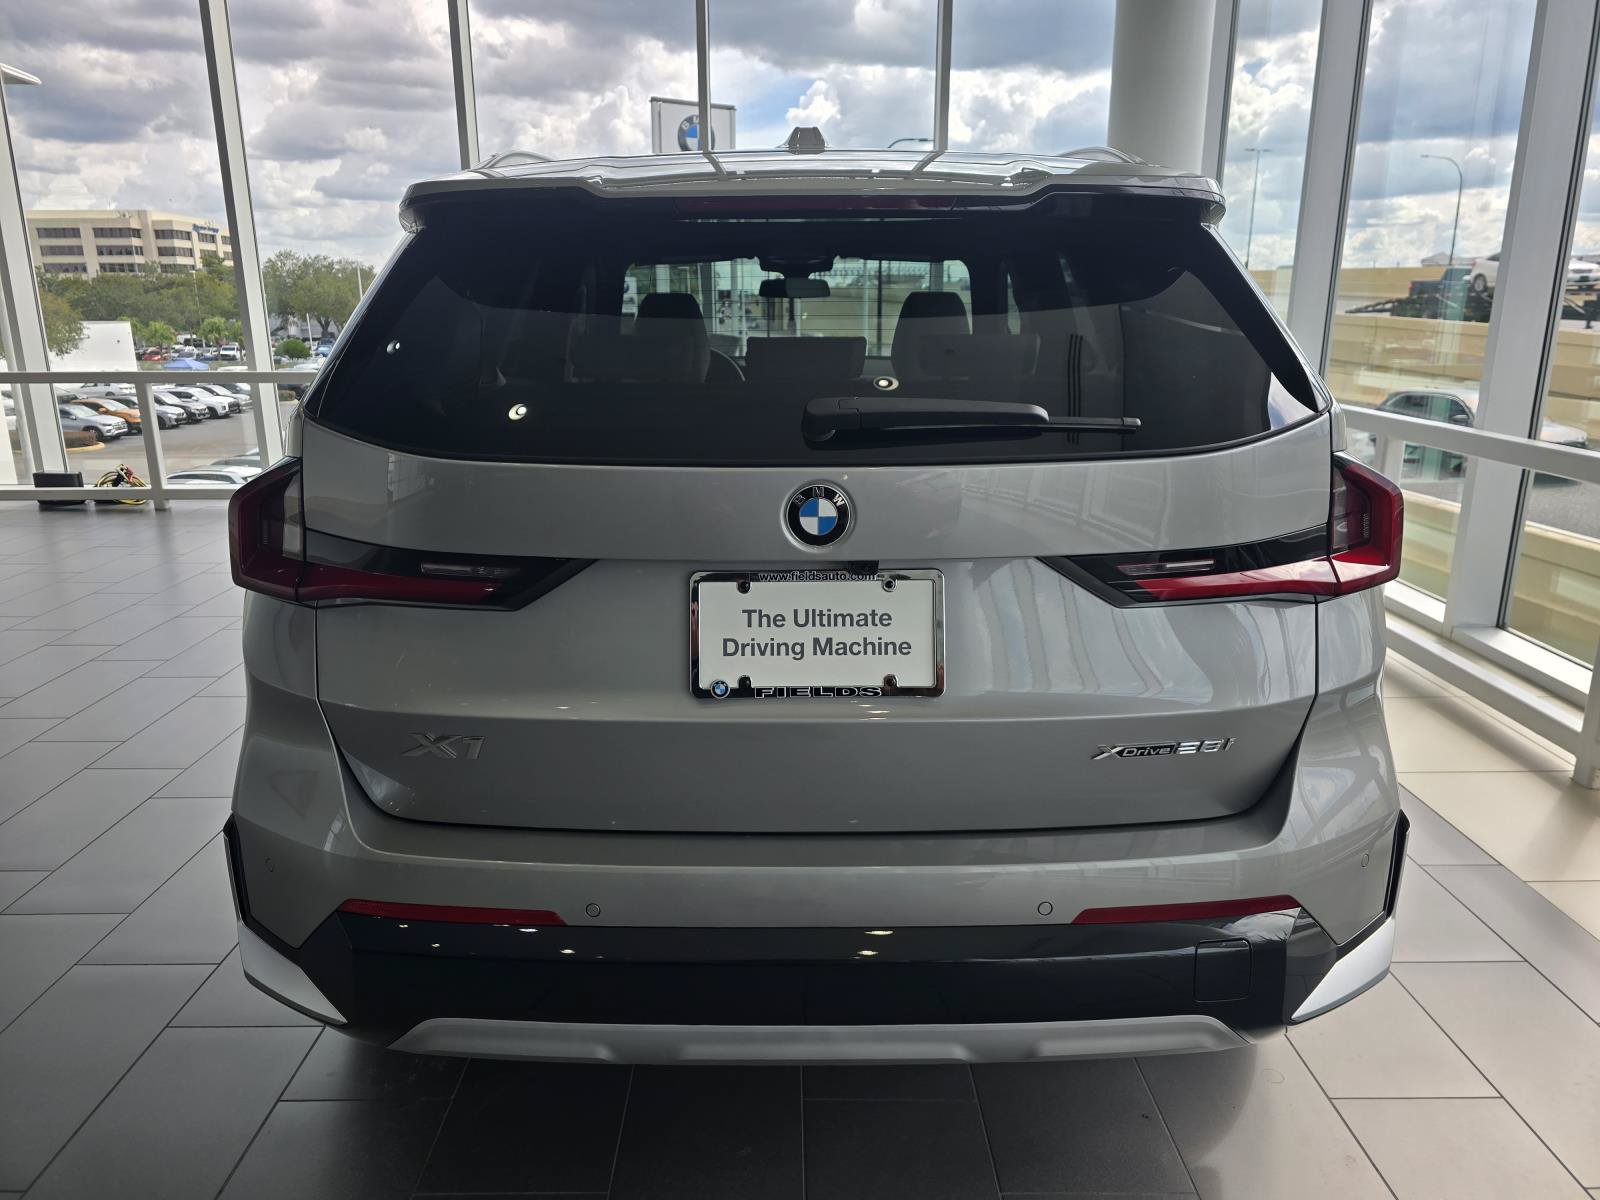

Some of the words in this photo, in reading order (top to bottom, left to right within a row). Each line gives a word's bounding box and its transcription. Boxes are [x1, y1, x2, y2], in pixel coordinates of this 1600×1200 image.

[793, 486, 845, 507] BMW
[759, 570, 877, 582] www.fieldsauto.com
[742, 608, 786, 628] The
[793, 608, 893, 628] Ultimate
[722, 637, 805, 661] Driving
[812, 636, 912, 656] Machine
[754, 686, 882, 698] FIELDS
[400, 730, 485, 760] X1
